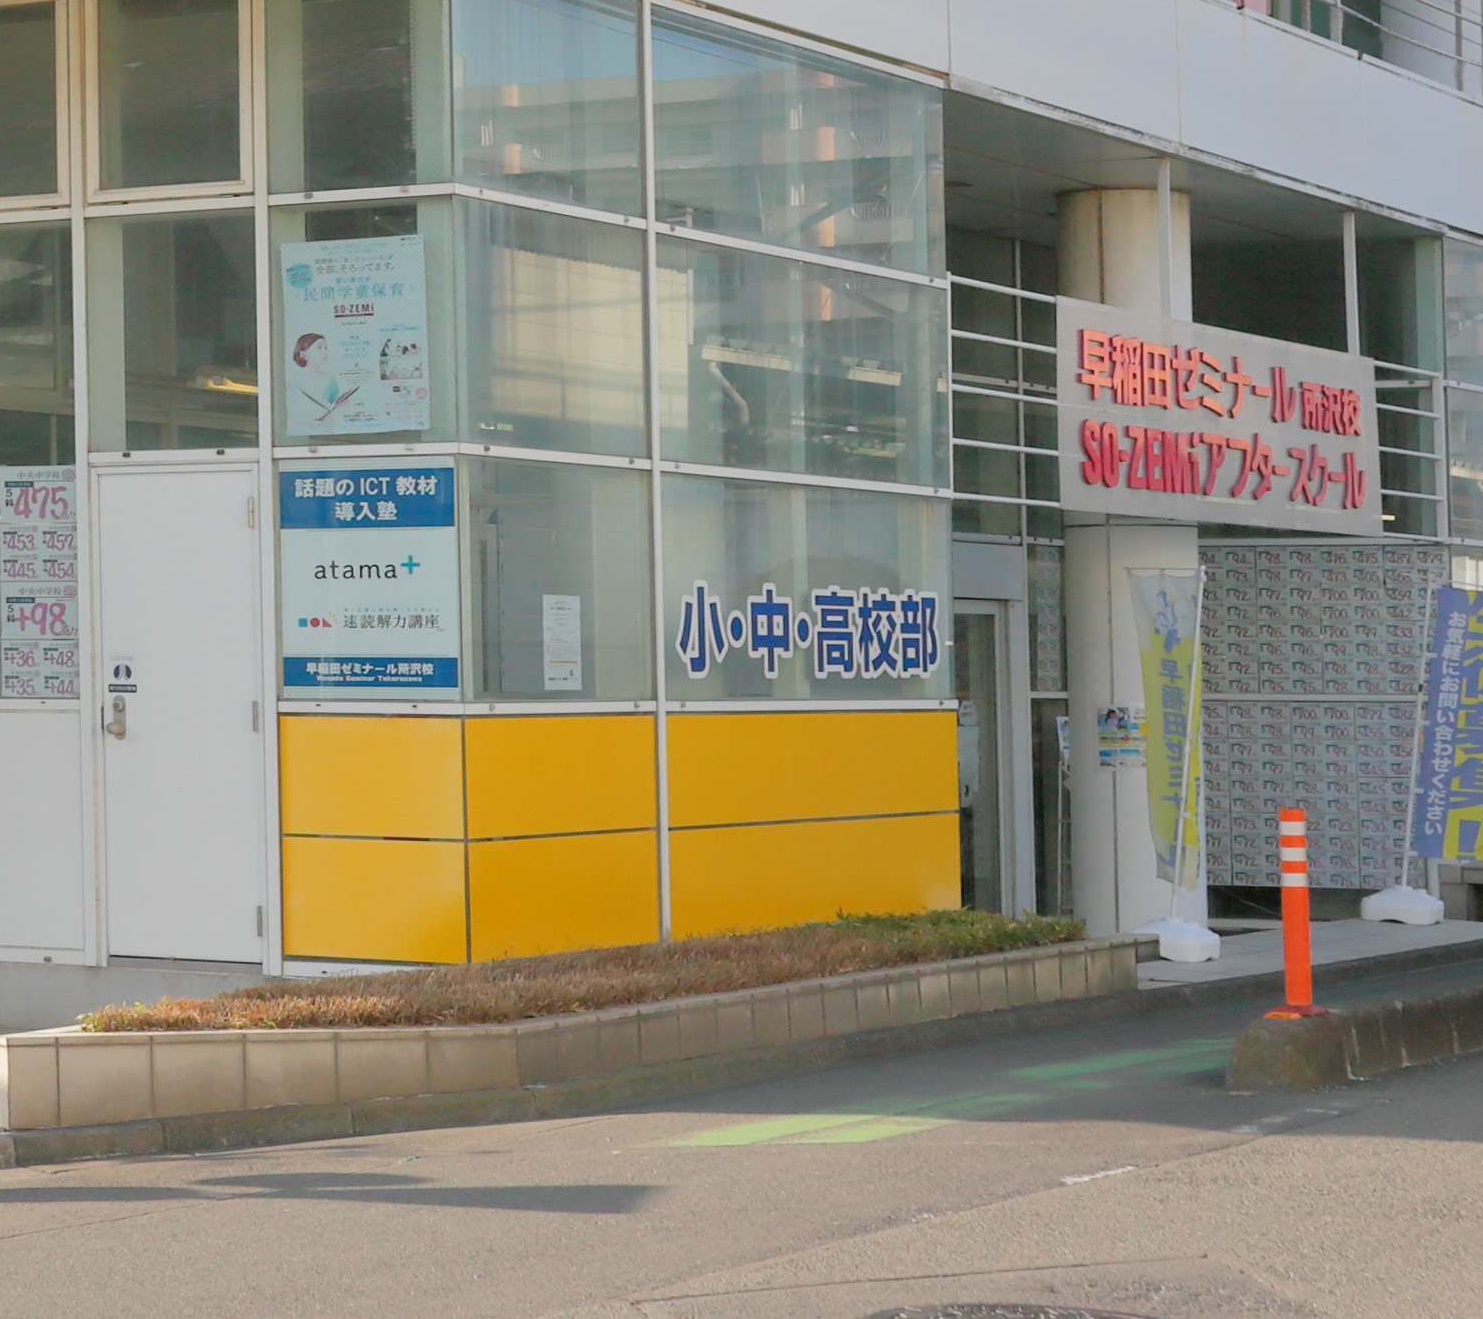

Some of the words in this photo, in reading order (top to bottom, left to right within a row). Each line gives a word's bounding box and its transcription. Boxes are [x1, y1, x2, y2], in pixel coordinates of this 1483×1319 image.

[1077, 328, 1297, 423] 早稲田ゼミナール
[1299, 381, 1362, 436] 所沢校
[335, 501, 398, 521] 導入塾
[360, 477, 389, 496] ICT
[396, 475, 437, 496] 教材
[676, 580, 938, 679] 小・中・高校部
